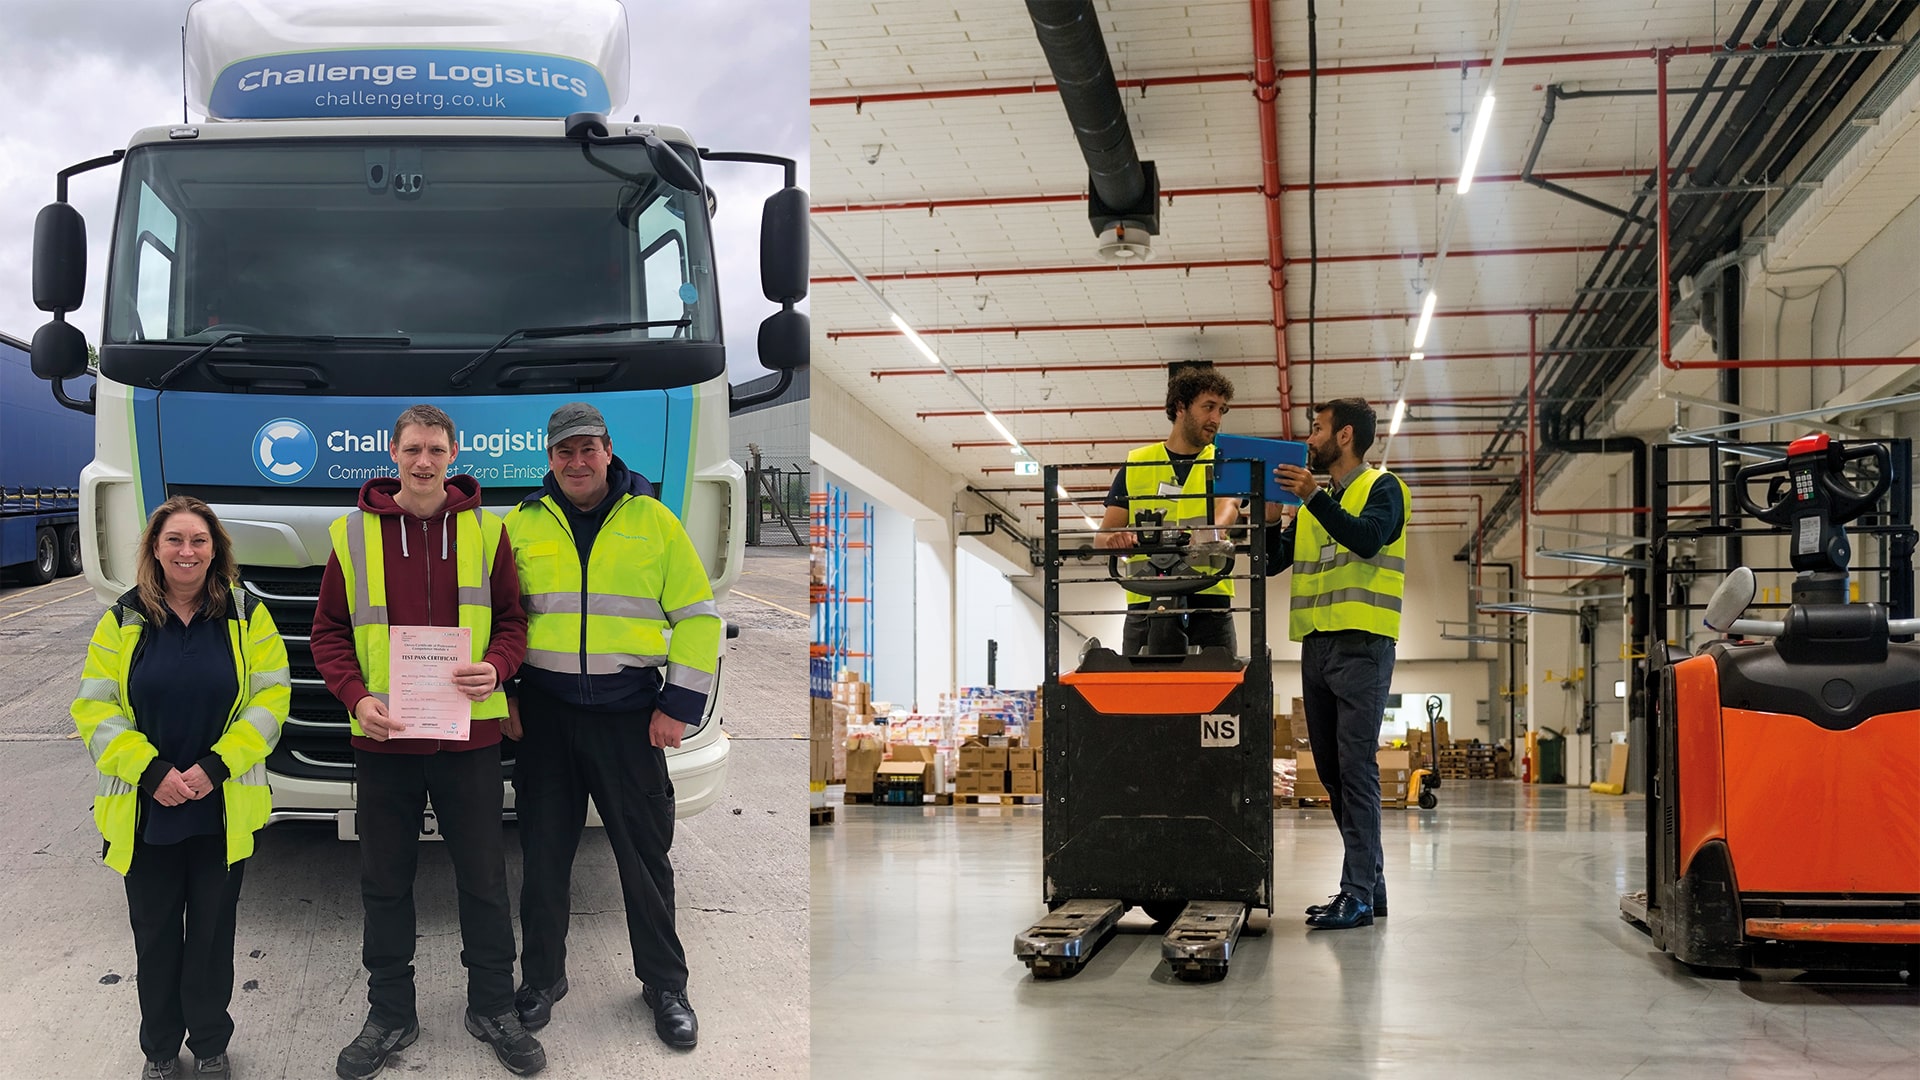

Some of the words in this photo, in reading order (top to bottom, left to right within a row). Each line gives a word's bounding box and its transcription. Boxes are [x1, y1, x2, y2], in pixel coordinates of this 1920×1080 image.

[238, 63, 417, 92] Challenge
[429, 62, 588, 98] Logistics
[315, 91, 506, 110] challengetrg.co.uk
[326, 429, 389, 452] Chall
[459, 428, 549, 458] Logisti
[328, 464, 401, 479] Committe
[445, 466, 459, 479] et
[462, 464, 499, 479] Zero
[503, 463, 551, 479] Emissi
[1203, 720, 1236, 740] NS
